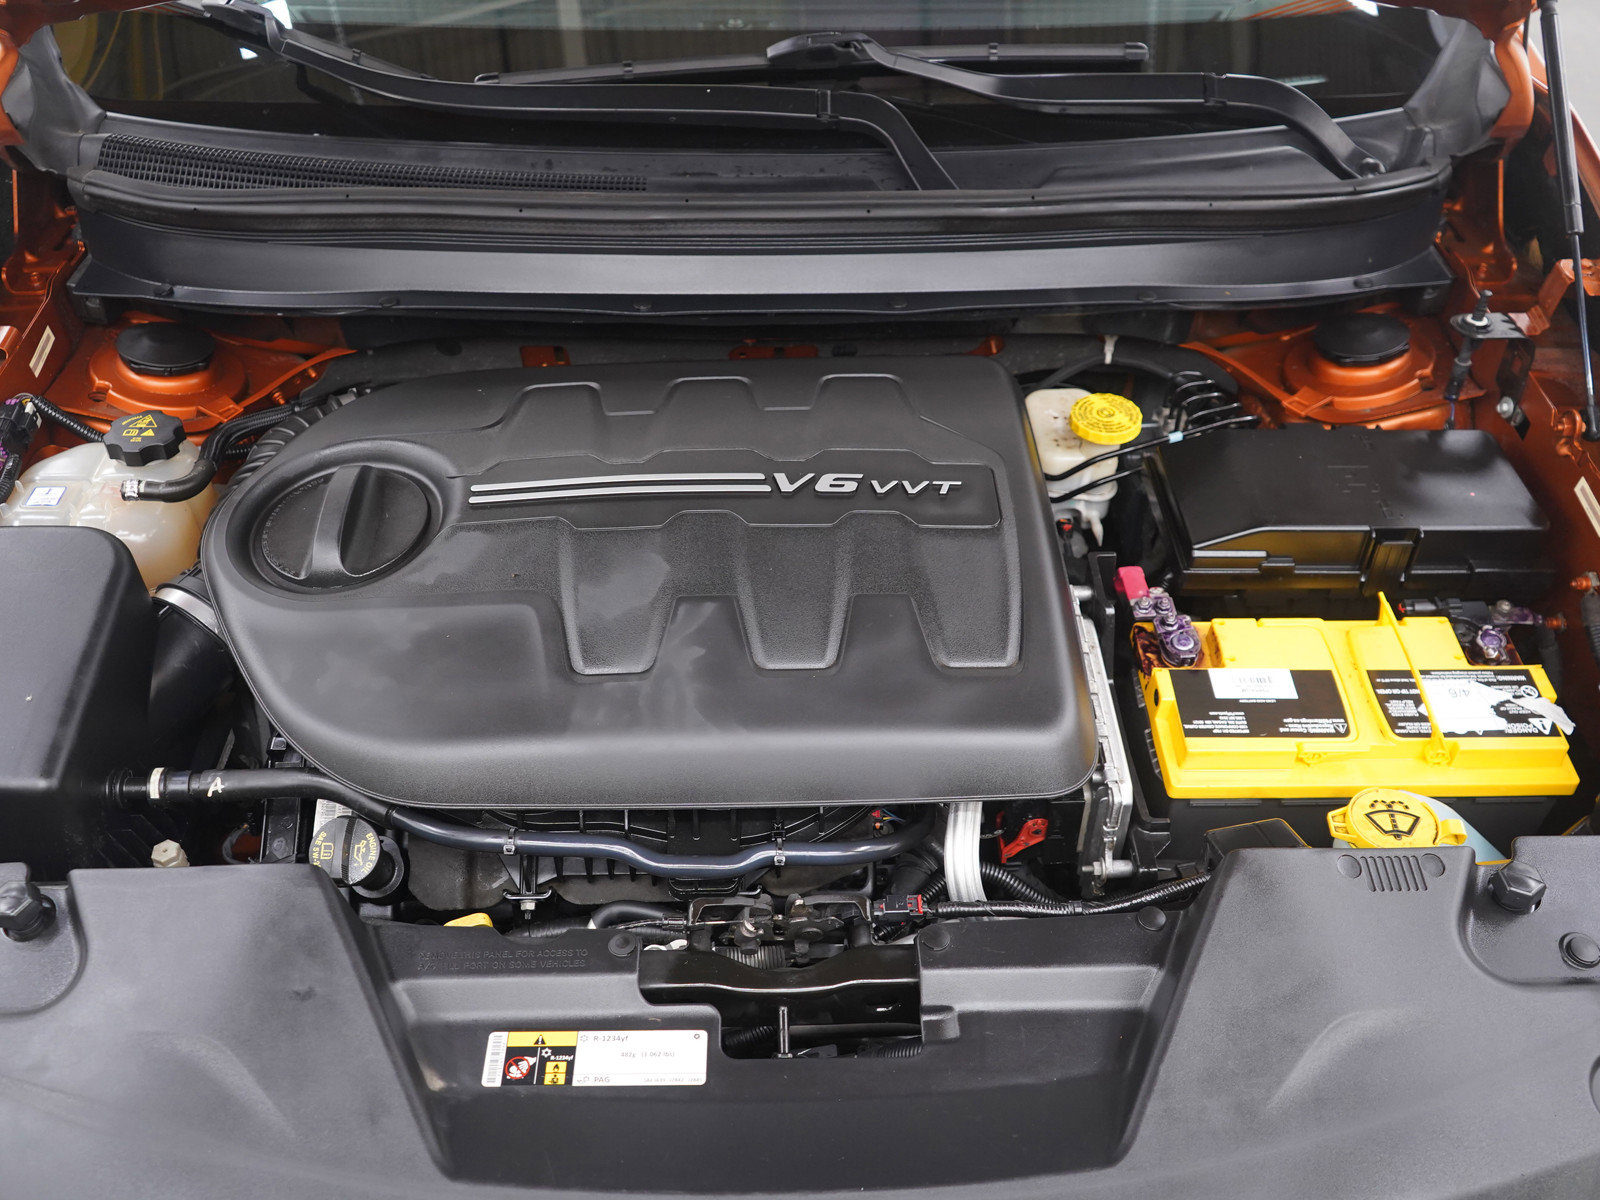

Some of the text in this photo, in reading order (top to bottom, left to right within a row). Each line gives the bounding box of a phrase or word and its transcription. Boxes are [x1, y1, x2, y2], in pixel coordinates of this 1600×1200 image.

[773, 472, 962, 494] V6 VVT
[312, 831, 327, 868] SAE 5W-2
[361, 832, 377, 874] ENGINE OIL
[483, 950, 513, 958] PANEL
[536, 949, 574, 957] ACCESS
[576, 949, 588, 957] TO
[492, 961, 506, 969] ON
[508, 960, 537, 968] SOME
[540, 959, 586, 968] VEHICLES
